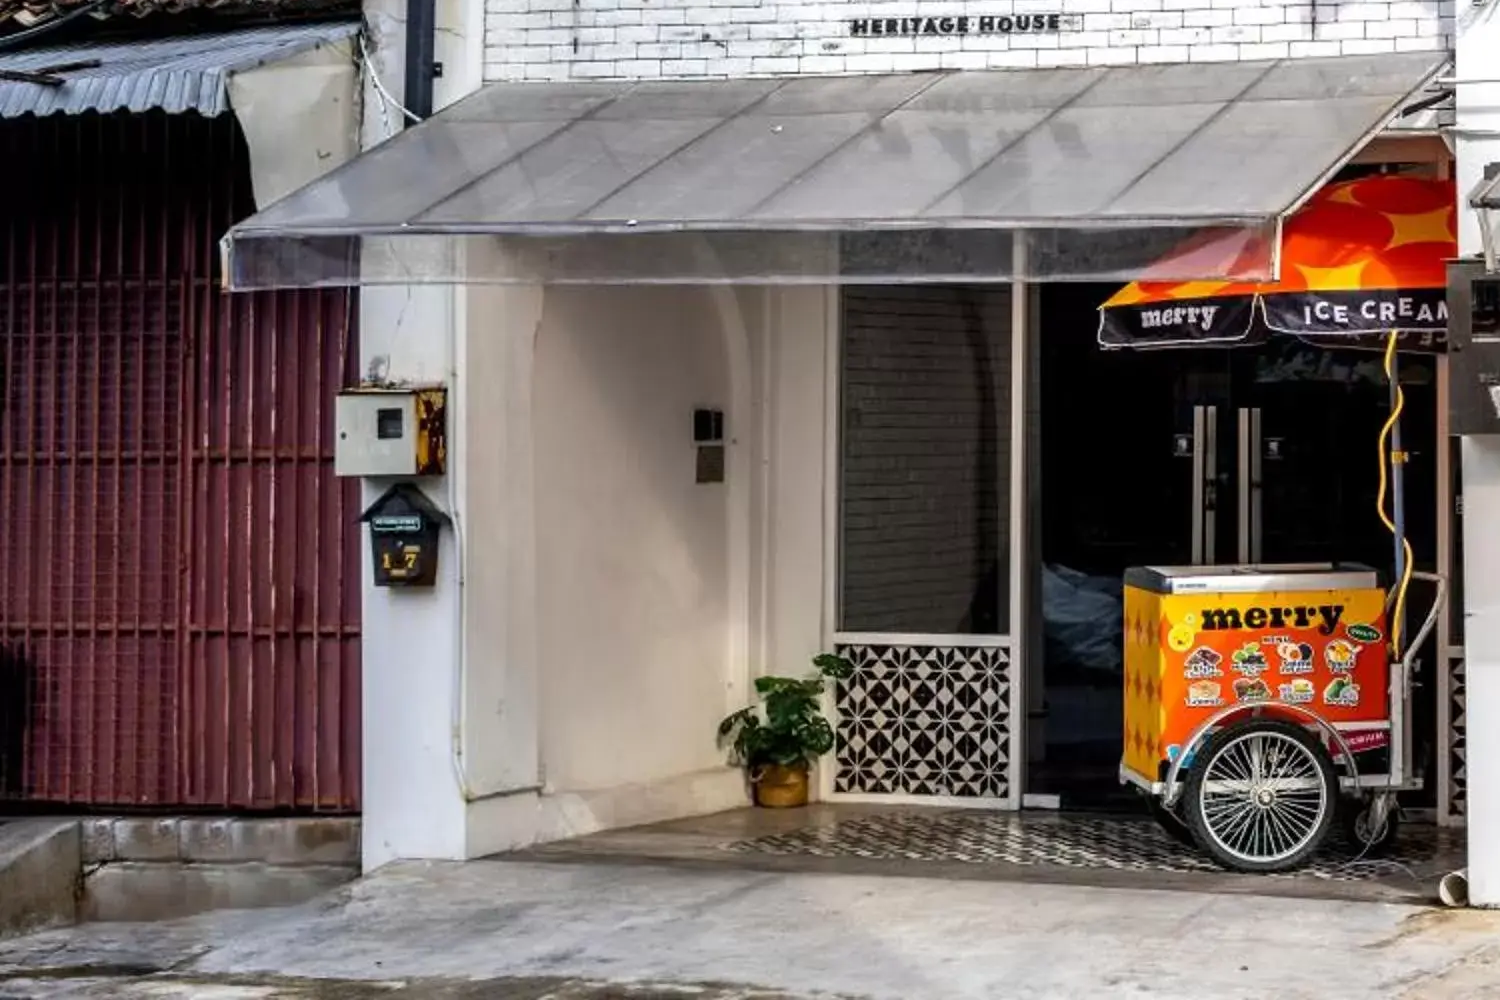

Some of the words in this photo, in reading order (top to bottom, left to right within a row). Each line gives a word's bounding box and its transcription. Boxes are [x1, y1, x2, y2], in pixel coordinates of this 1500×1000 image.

[852, 16, 969, 35] HERITAGE
[979, 14, 1060, 33] HOUSE
[1141, 305, 1219, 331] merry
[1304, 301, 1349, 325] ICE
[1201, 605, 1344, 636] merry
